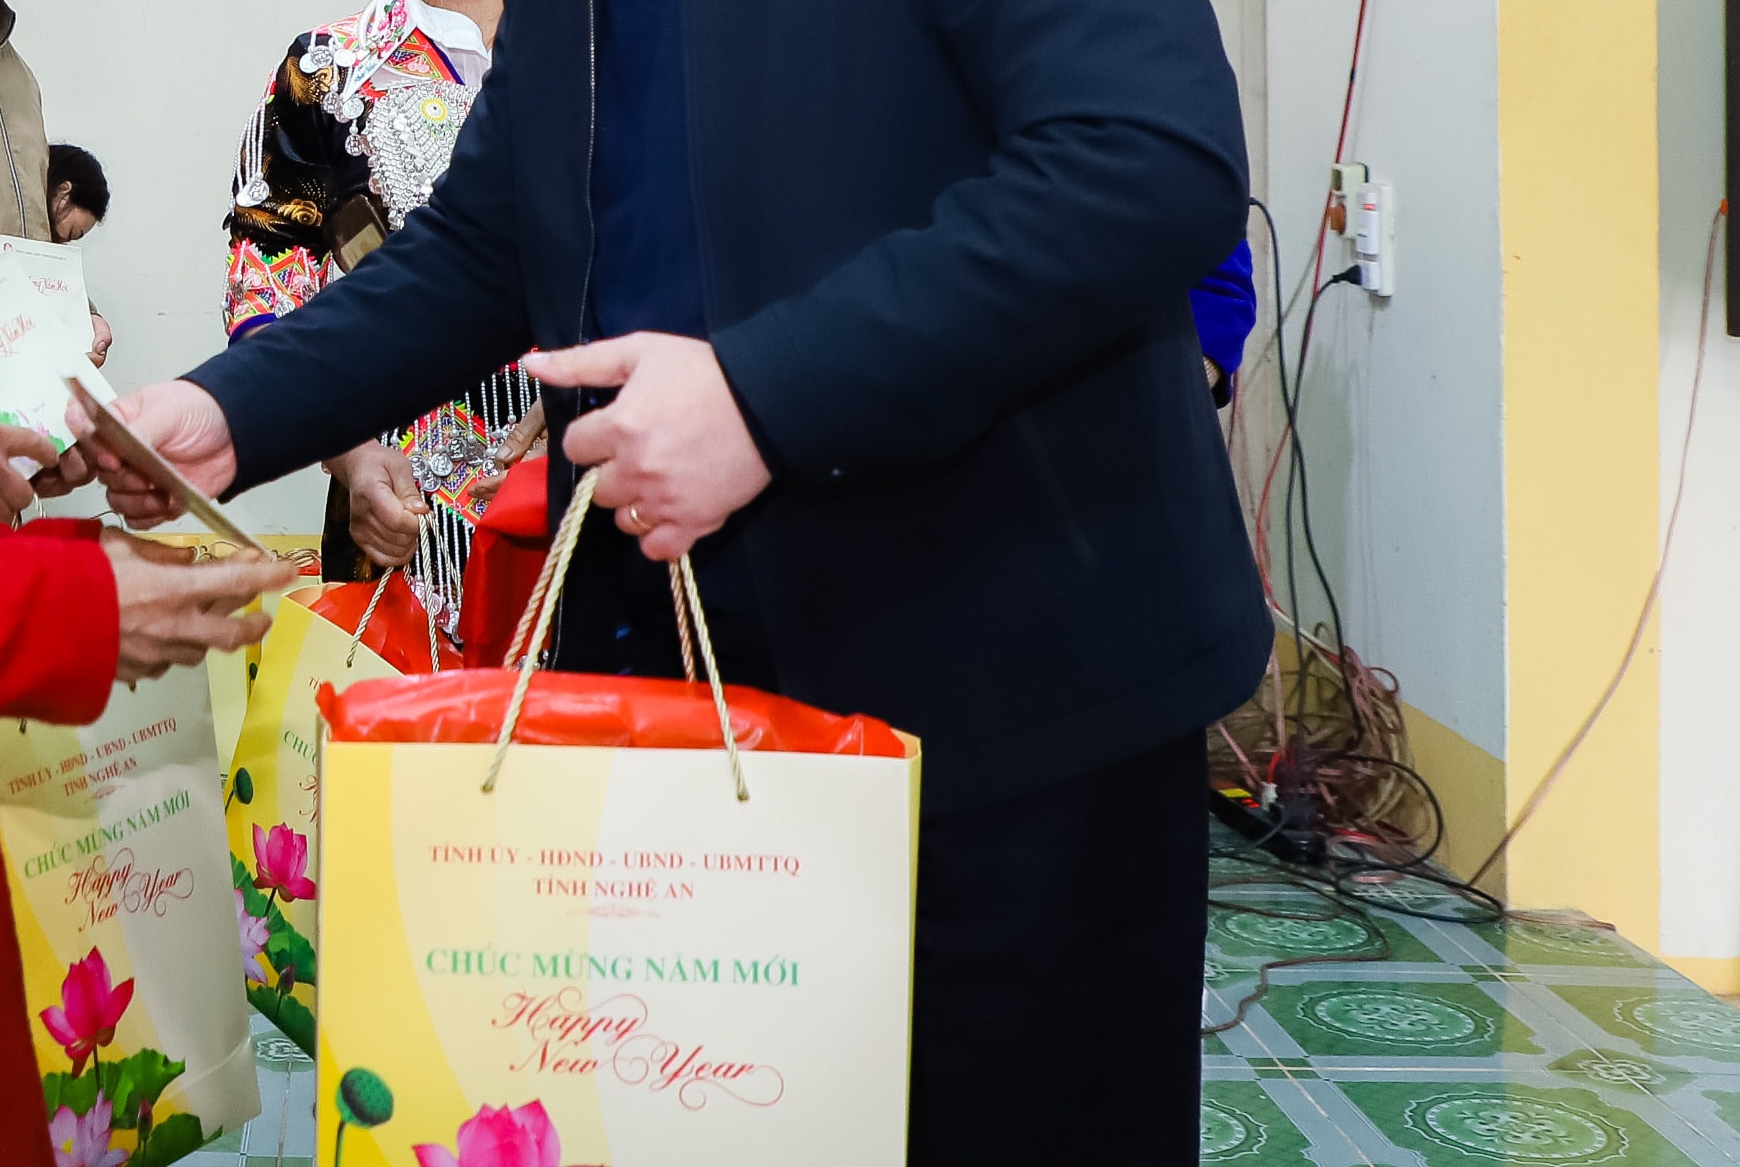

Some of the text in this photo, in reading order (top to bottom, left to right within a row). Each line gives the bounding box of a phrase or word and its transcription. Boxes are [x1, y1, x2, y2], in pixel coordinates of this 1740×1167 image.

[96, 737, 127, 759] UBND
[132, 717, 177, 744] UBMTTQ
[123, 756, 138, 772] AN
[24, 842, 73, 879] CHÚC
[64, 847, 135, 905] Happy
[428, 841, 483, 864] TỈNH
[623, 851, 683, 870] UBND
[702, 852, 801, 877] UBMTTQ
[79, 867, 195, 933] New Year
[532, 872, 694, 902] TỈNH NGHỆ AN
[425, 942, 800, 987] CHÚC MỪNG NĂM MỚI
[491, 985, 648, 1047] Happy
[509, 1033, 785, 1111] New Year
